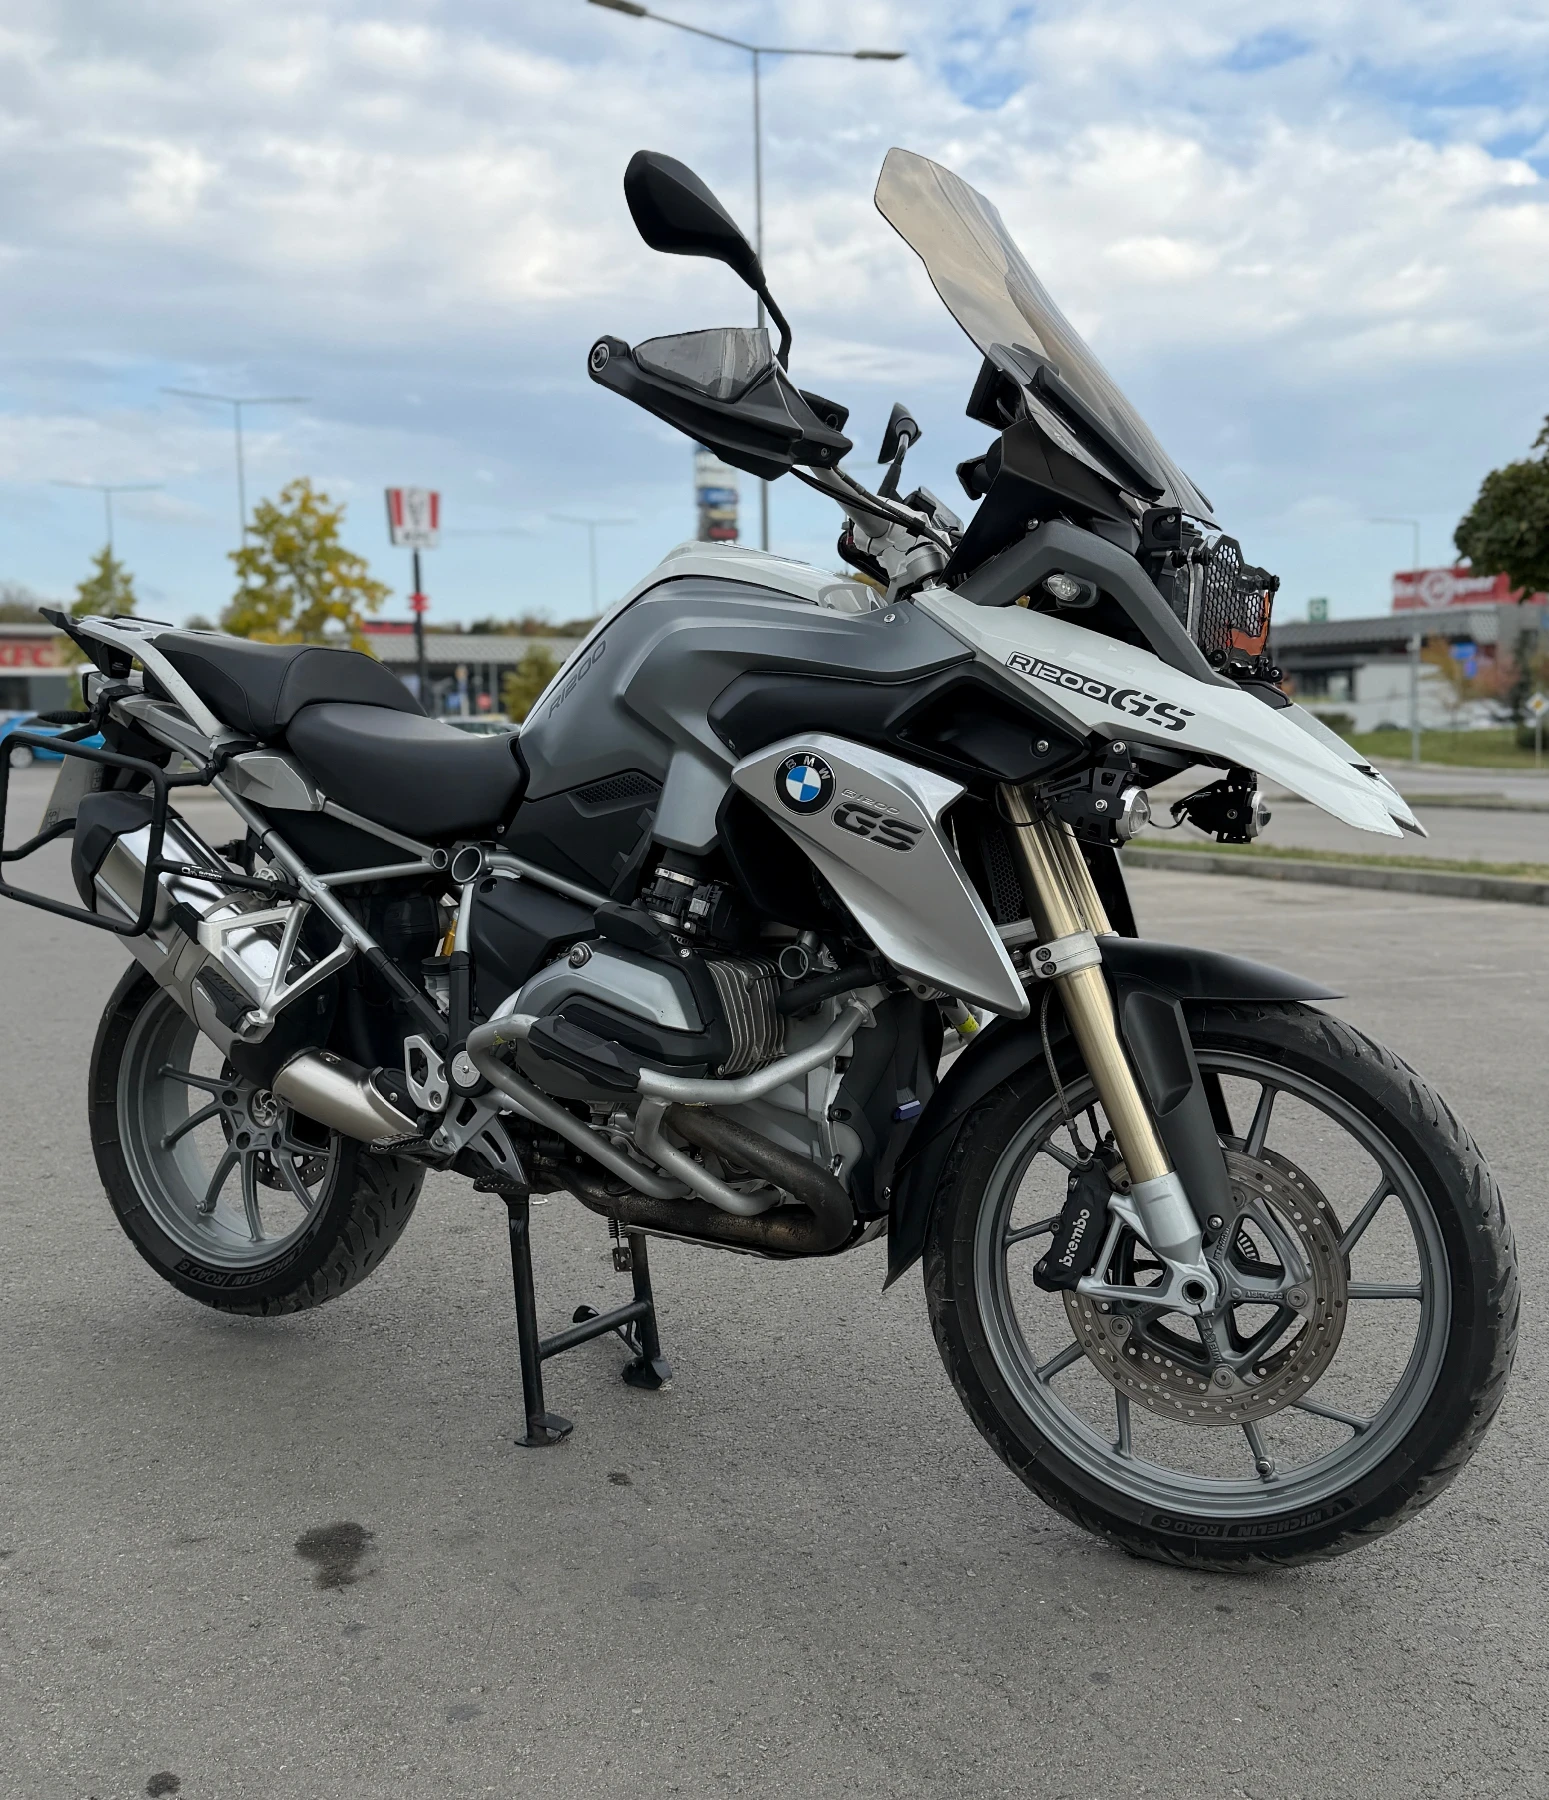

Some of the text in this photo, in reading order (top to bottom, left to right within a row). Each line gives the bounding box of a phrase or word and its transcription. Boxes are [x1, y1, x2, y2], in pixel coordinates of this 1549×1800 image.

[548, 640, 606, 719] R1200
[785, 755, 831, 780] BMW
[833, 802, 924, 851] GS
[1058, 1208, 1091, 1268] brembo
[189, 1267, 227, 1285] ROAD
[231, 1250, 297, 1286] MICHELIN
[1160, 1507, 1323, 1537] MICHELIN ROAD 6
